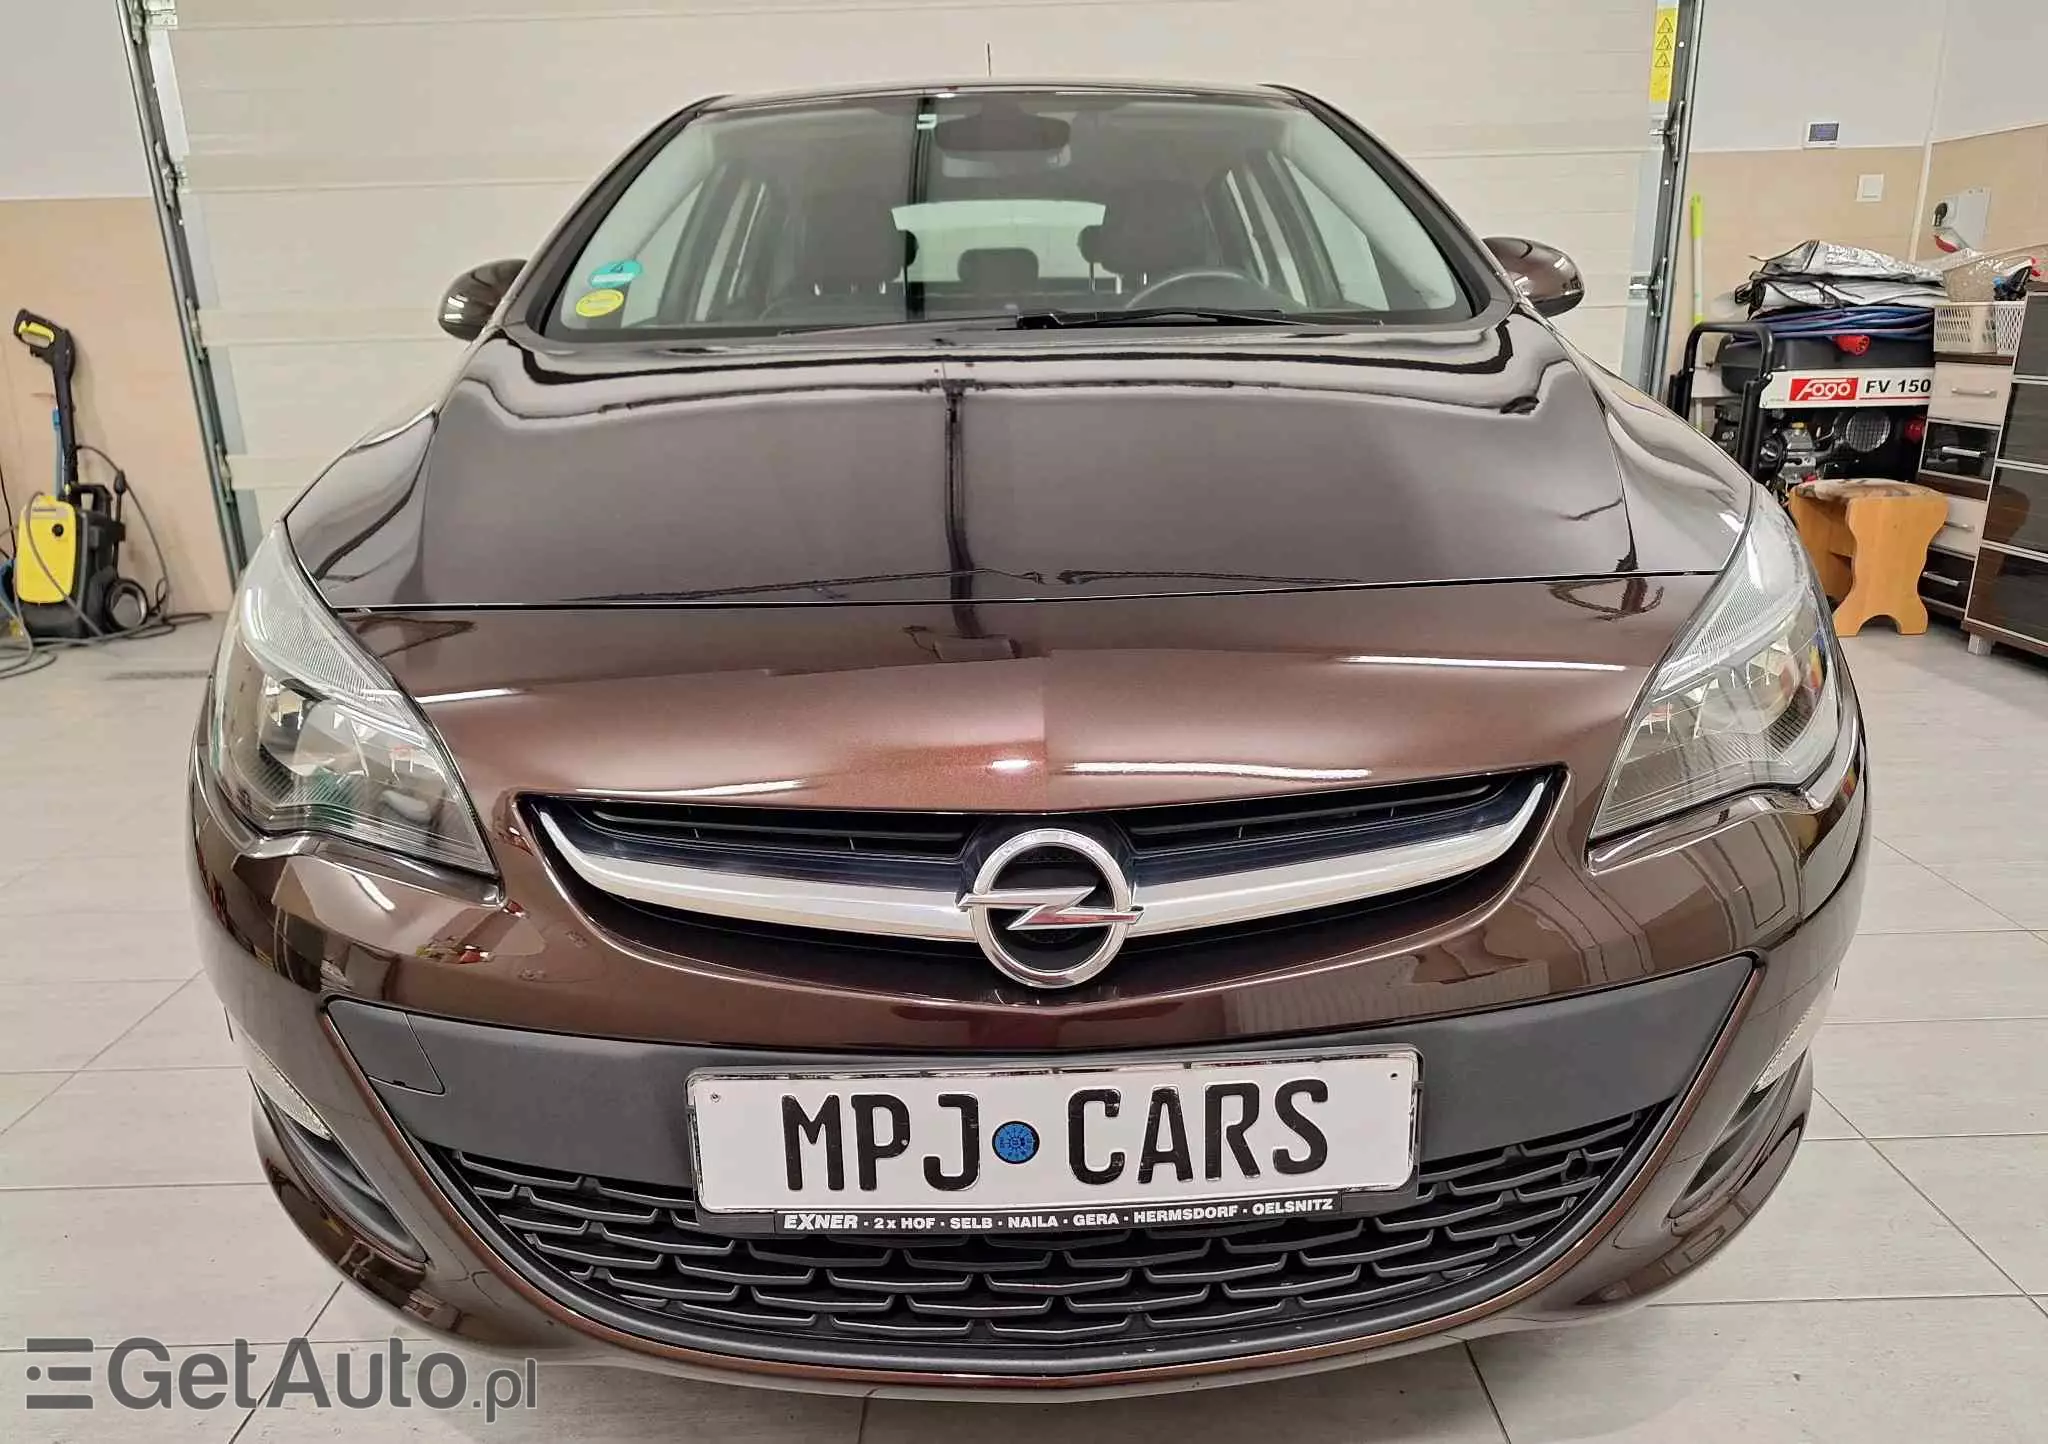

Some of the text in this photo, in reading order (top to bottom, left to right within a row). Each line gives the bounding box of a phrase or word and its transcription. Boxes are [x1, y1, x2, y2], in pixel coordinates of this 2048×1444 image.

[1865, 380, 1890, 393] FV
[782, 1080, 1329, 1191] MPJ CARS
[783, 1214, 858, 1230] EXNER
[901, 1217, 936, 1230] HOF
[950, 1216, 993, 1229] SELB
[1008, 1215, 1059, 1228] NAILA
[1072, 1213, 1119, 1226] GERA
[1133, 1205, 1239, 1223] HERMSDORF
[1252, 1198, 1333, 1216] OELSNITZ
